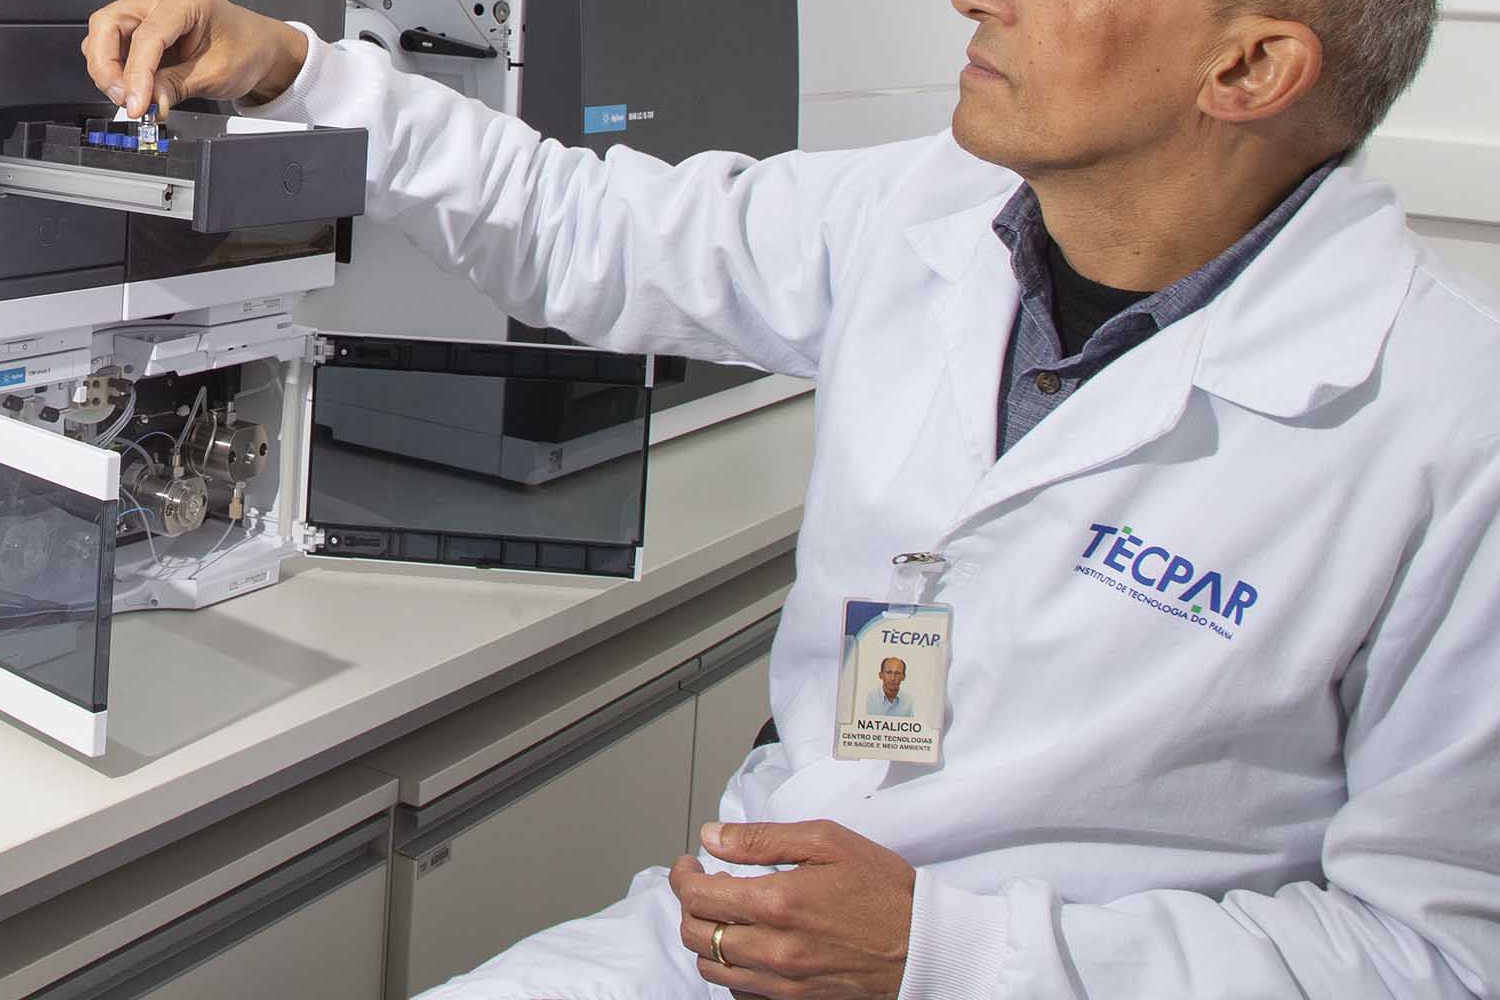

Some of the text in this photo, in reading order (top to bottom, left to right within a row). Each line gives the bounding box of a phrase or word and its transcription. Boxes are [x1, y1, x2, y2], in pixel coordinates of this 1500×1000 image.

[1082, 523, 1258, 626] TECPAR
[1075, 564, 1116, 587] INSTITUTO
[1115, 582, 1128, 593] DE
[1128, 588, 1188, 620] TECNOLOGIA
[1190, 614, 1208, 626] DO
[857, 719, 922, 733] NATALICIO
[842, 733, 871, 741] CENTRO
[884, 735, 933, 744] TECNOLOGIAS
[899, 744, 932, 752] AMBIENTE
